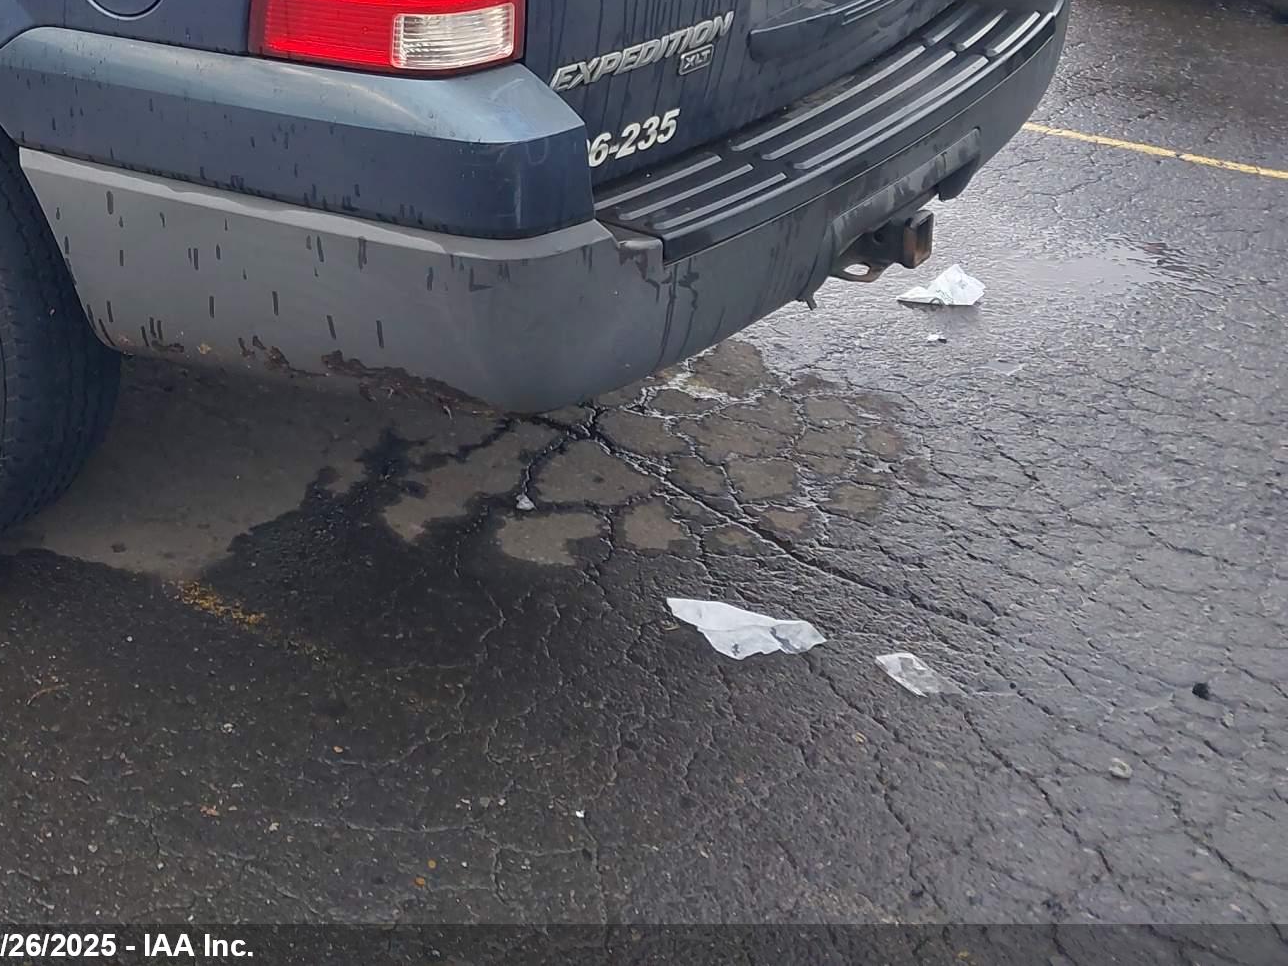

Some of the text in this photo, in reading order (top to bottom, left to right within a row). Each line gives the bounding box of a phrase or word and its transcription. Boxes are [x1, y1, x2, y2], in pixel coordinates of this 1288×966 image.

[549, 10, 735, 91] EXPEDITION
[684, 48, 711, 70] XLT
[586, 108, 681, 168] 6-235
